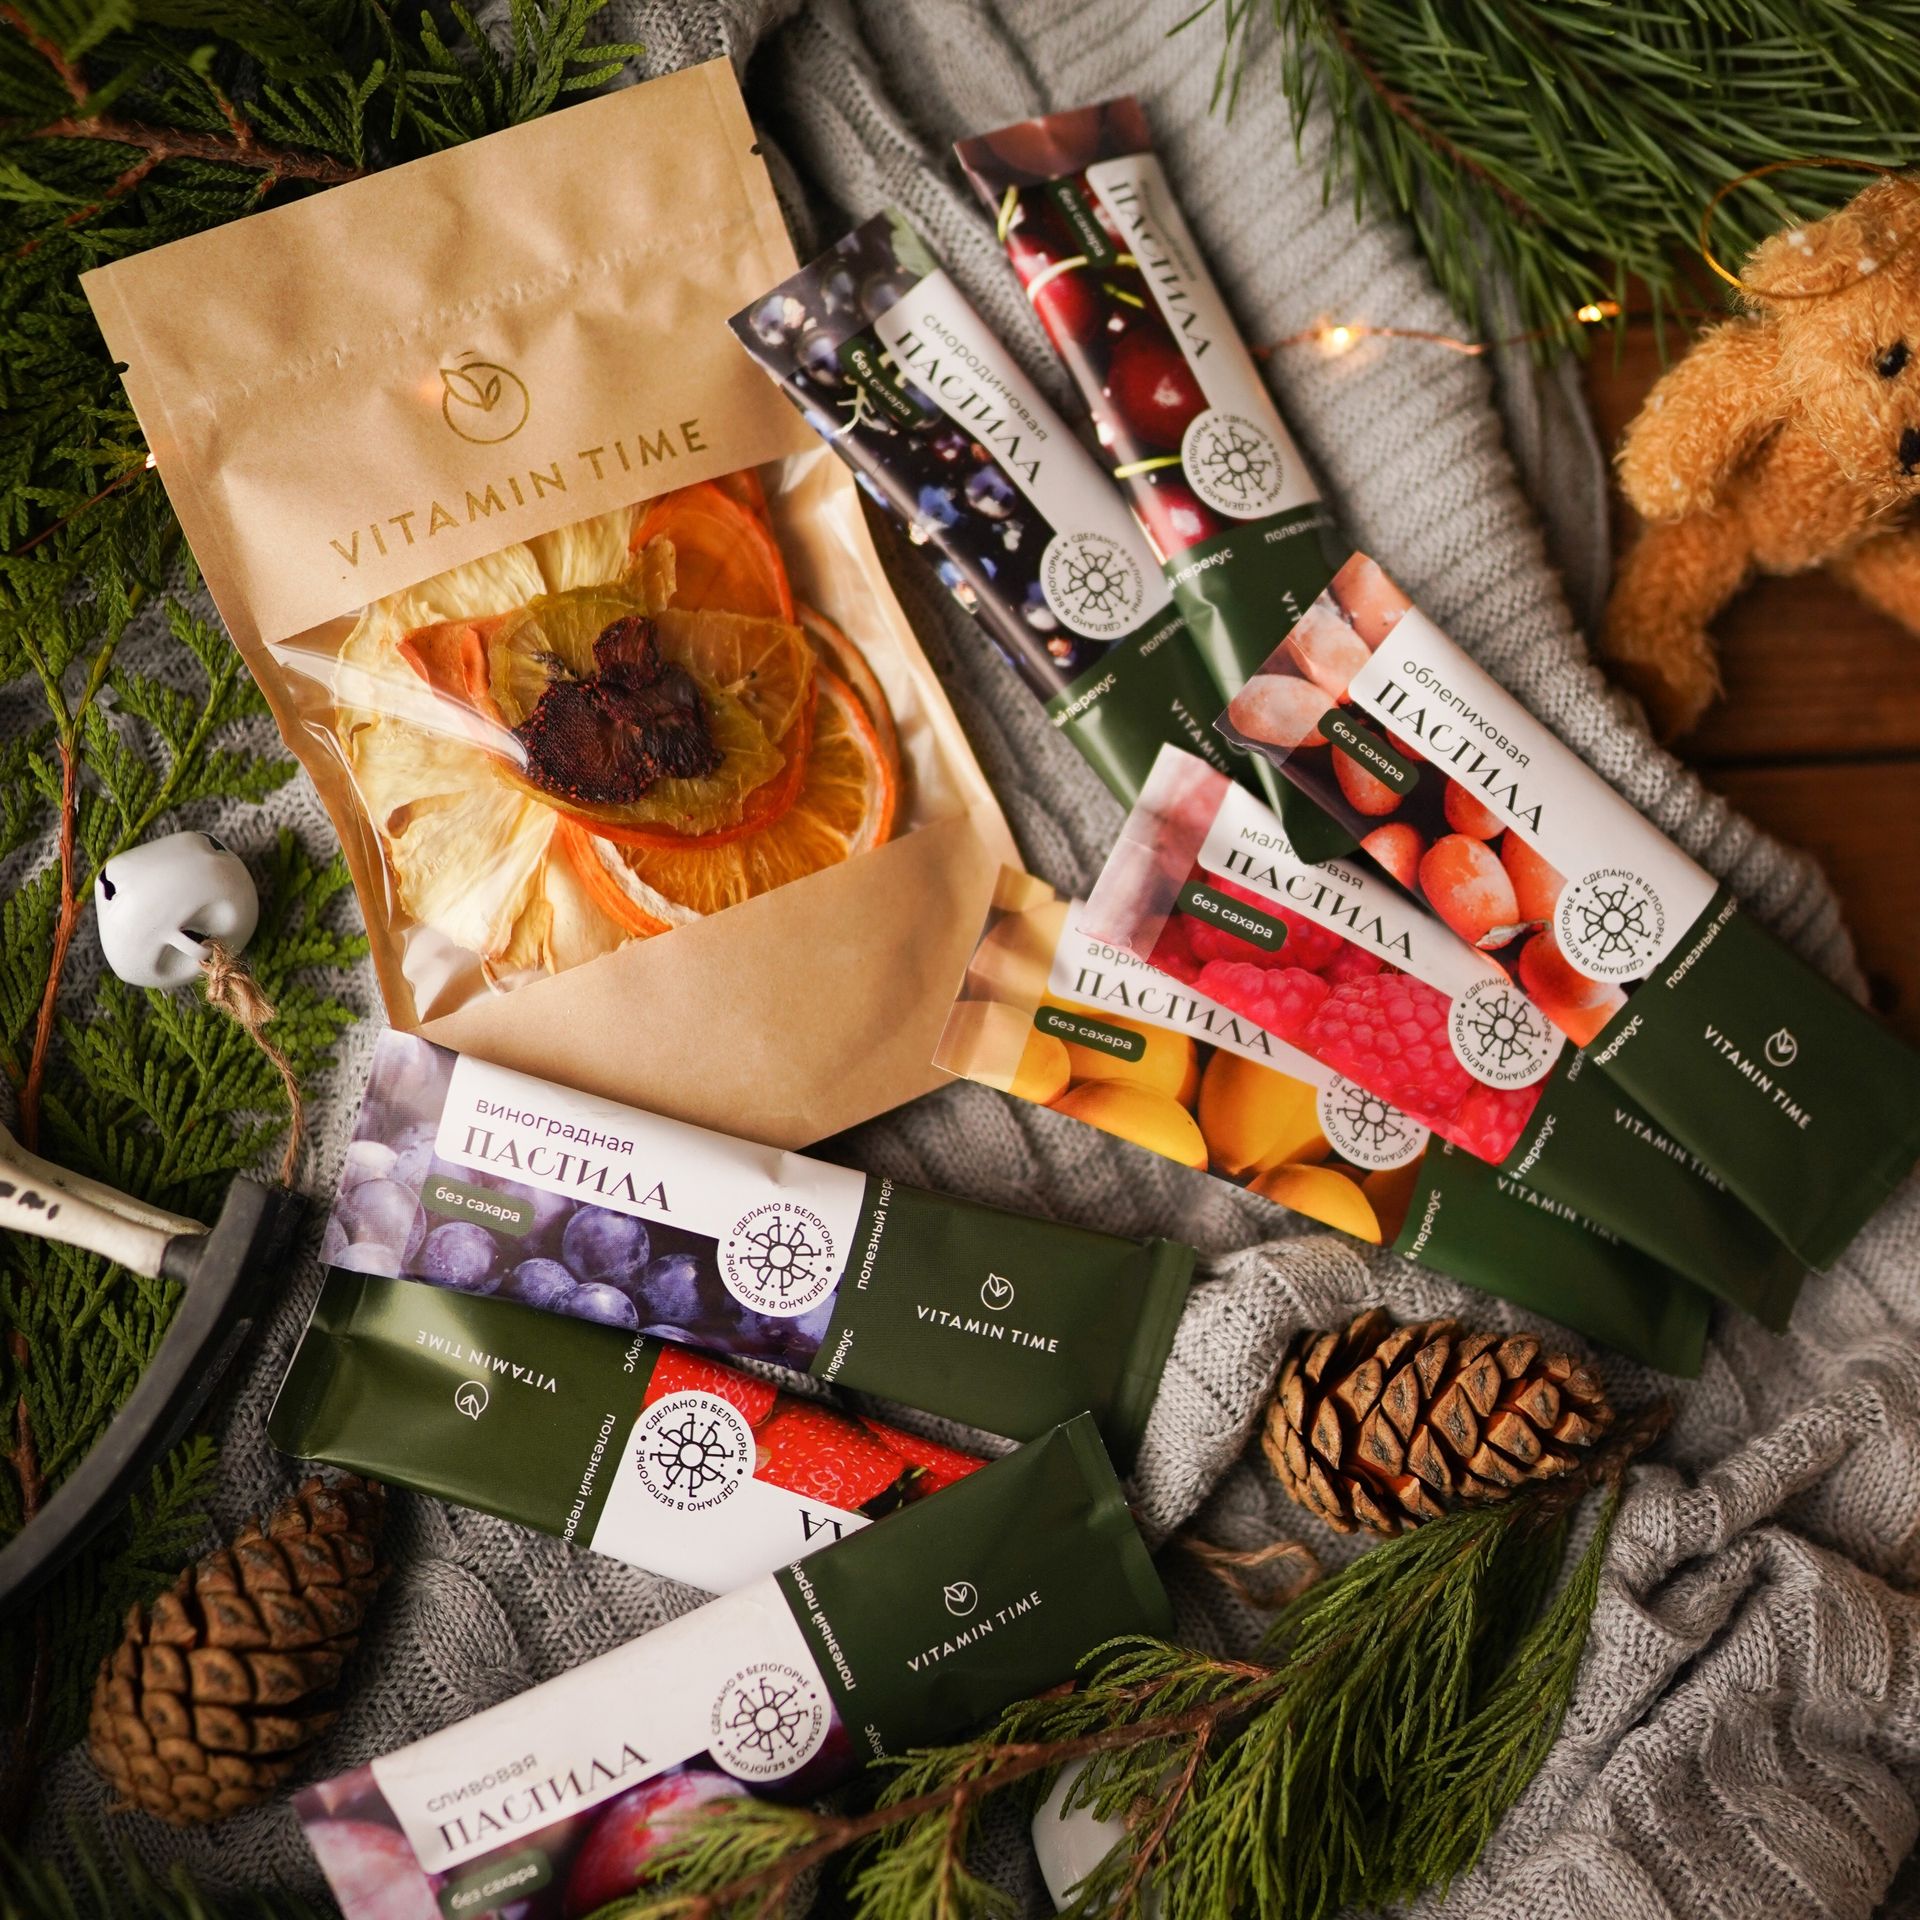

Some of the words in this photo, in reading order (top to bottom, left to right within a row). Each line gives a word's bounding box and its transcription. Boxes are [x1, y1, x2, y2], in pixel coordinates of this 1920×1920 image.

[1107, 182, 1211, 358] ПАСТИЛА
[851, 350, 872, 378] без
[869, 374, 911, 417] сахара
[893, 330, 1042, 488] ПАСТИЛА
[922, 314, 1048, 442] смородиновая
[329, 462, 567, 568] VITAMIN
[578, 418, 709, 480] TIME
[1176, 549, 1233, 584] перекус
[1066, 673, 1116, 718] перекус
[1402, 660, 1531, 769] облепиховая
[1170, 698, 1230, 773] VITAMIN
[1332, 721, 1357, 745] без
[1357, 741, 1405, 783] сахара
[1373, 679, 1544, 836] ПАСТИЛА
[1192, 892, 1219, 914] без
[1221, 907, 1273, 939] сахара
[1224, 847, 1414, 961] ПАСТИЛА
[1562, 896, 1583, 960] БЕЛОГОРЬЕ
[1582, 869, 1634, 886] СДЕЛАНО
[1642, 883, 1665, 946] БЕЛОГОРЬЕ
[1591, 958, 1644, 975] СДЕЛАНО
[1665, 921, 1722, 989] полезный
[1048, 1015, 1075, 1032] без
[1078, 1024, 1133, 1051] сахара
[1073, 966, 1274, 1058] ПАСТИЛА
[1593, 1014, 1643, 1066] перекус
[1704, 1024, 1773, 1092] VITAMIN
[1772, 1087, 1812, 1130] TIME
[475, 1099, 635, 1155] виноградная
[1518, 1114, 1557, 1174] перекус
[1614, 1108, 1686, 1164] VITAMIN
[461, 1125, 672, 1212] ПАСТИЛА
[1497, 1176, 1576, 1222] VITAMIN
[435, 1186, 463, 1205] без
[466, 1196, 521, 1223] сахара
[732, 1202, 781, 1237] СДЕЛАНО
[794, 1205, 835, 1259] БЕЛОГОРЬЕ
[1412, 1189, 1441, 1251] перекус
[726, 1253, 766, 1307] БЕЛОГОРЬЕ
[857, 1210, 888, 1290] полезный
[779, 1277, 828, 1310] СДЕЛАНО
[416, 1330, 461, 1359] TIME
[827, 1328, 854, 1378] перекус
[917, 1305, 1004, 1340] VITAMIN
[1011, 1329, 1060, 1353] TIME
[468, 1348, 557, 1394] VITAMIN
[579, 1413, 616, 1496] полезный
[645, 1398, 698, 1430] СДЕЛАНО
[710, 1404, 748, 1463] БЕЛОГОРЬЕ
[636, 1448, 675, 1508] БЕЛОГОРЬЕ
[687, 1479, 739, 1512] СДЕЛАНО
[811, 1611, 857, 1691] полезный
[907, 1619, 993, 1672] VITAMIN
[996, 1590, 1042, 1625] TIME
[426, 1754, 538, 1813] сливовая
[439, 1742, 652, 1853] ПАСТИЛА
